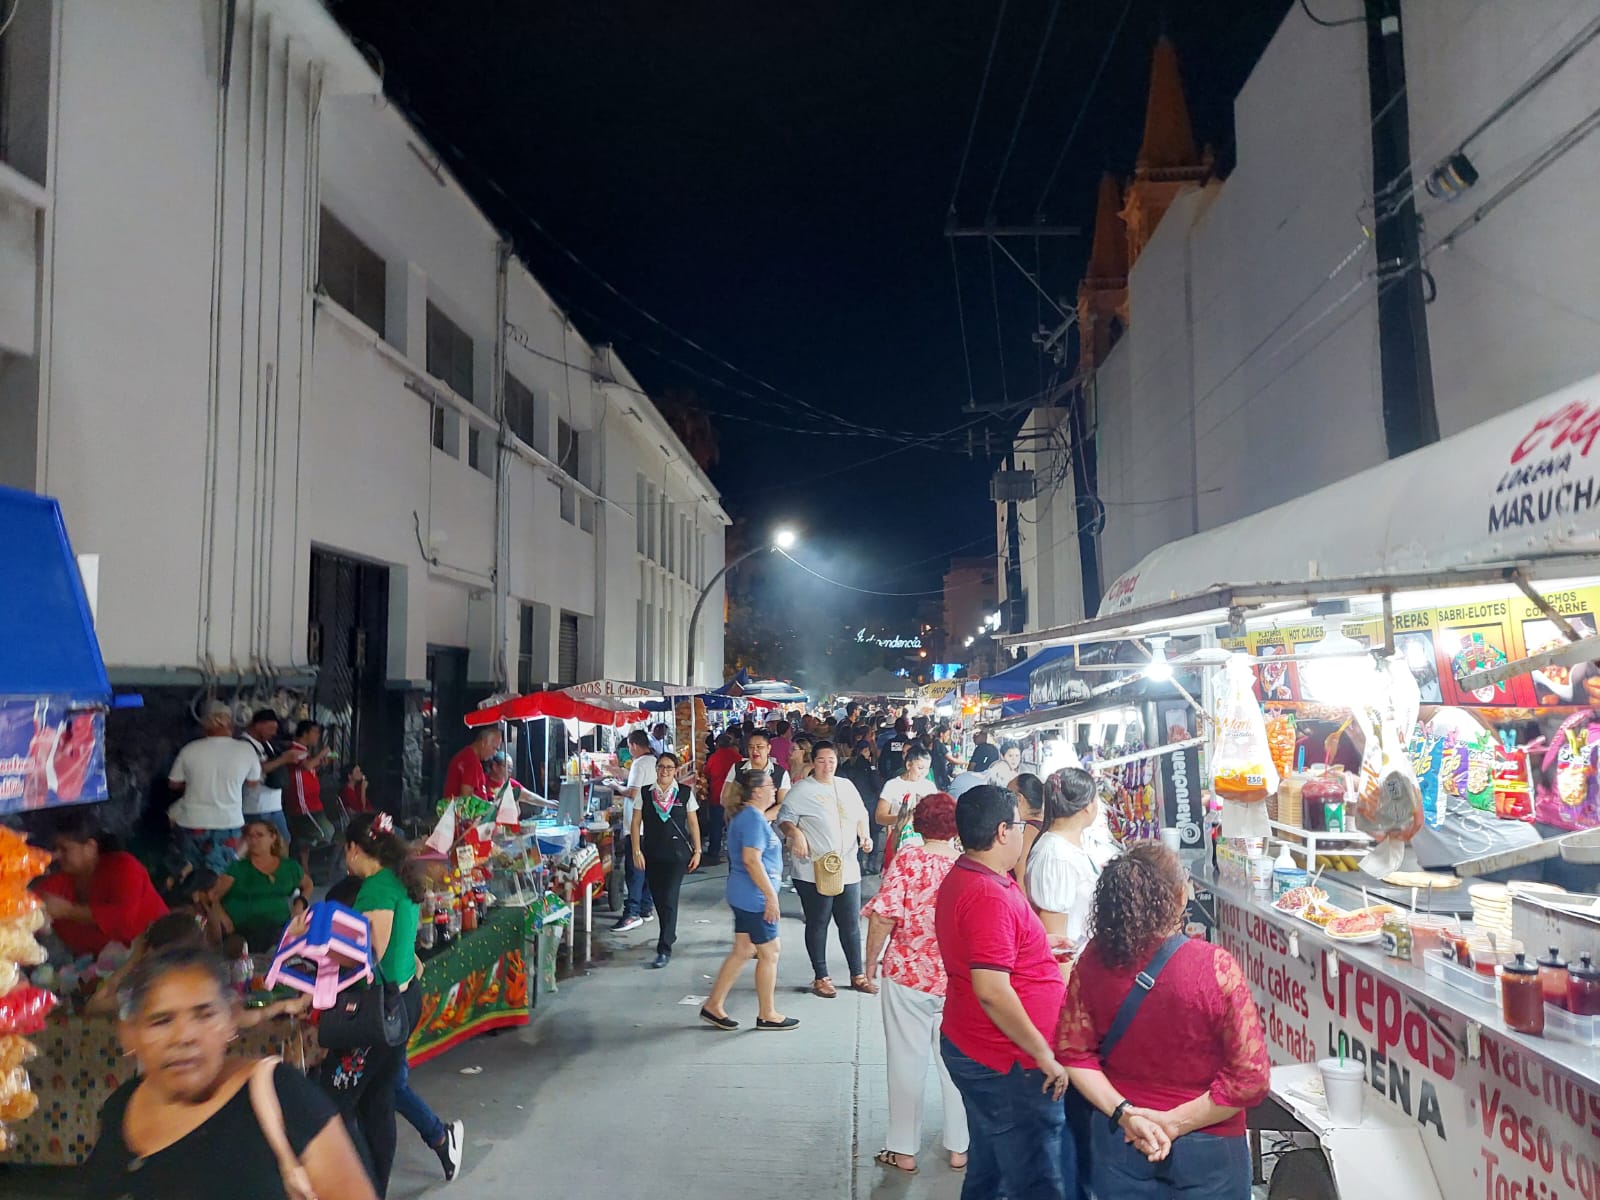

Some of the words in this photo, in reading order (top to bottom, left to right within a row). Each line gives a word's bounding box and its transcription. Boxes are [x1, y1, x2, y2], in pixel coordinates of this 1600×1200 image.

[1542, 592, 1577, 605] CHOS
[1393, 612, 1430, 630] REPAS
[1438, 603, 1507, 622] SABRI-ELOTES
[1525, 607, 1544, 618] CO
[1302, 626, 1324, 639] CAKES
[605, 681, 616, 696] EL
[618, 684, 650, 696] CHATO
[1246, 942, 1265, 991] hot
[1268, 964, 1309, 1019] cakes
[1269, 1003, 1284, 1049] de
[1286, 1023, 1316, 1064] nata
[1479, 1081, 1554, 1173] Vaso
